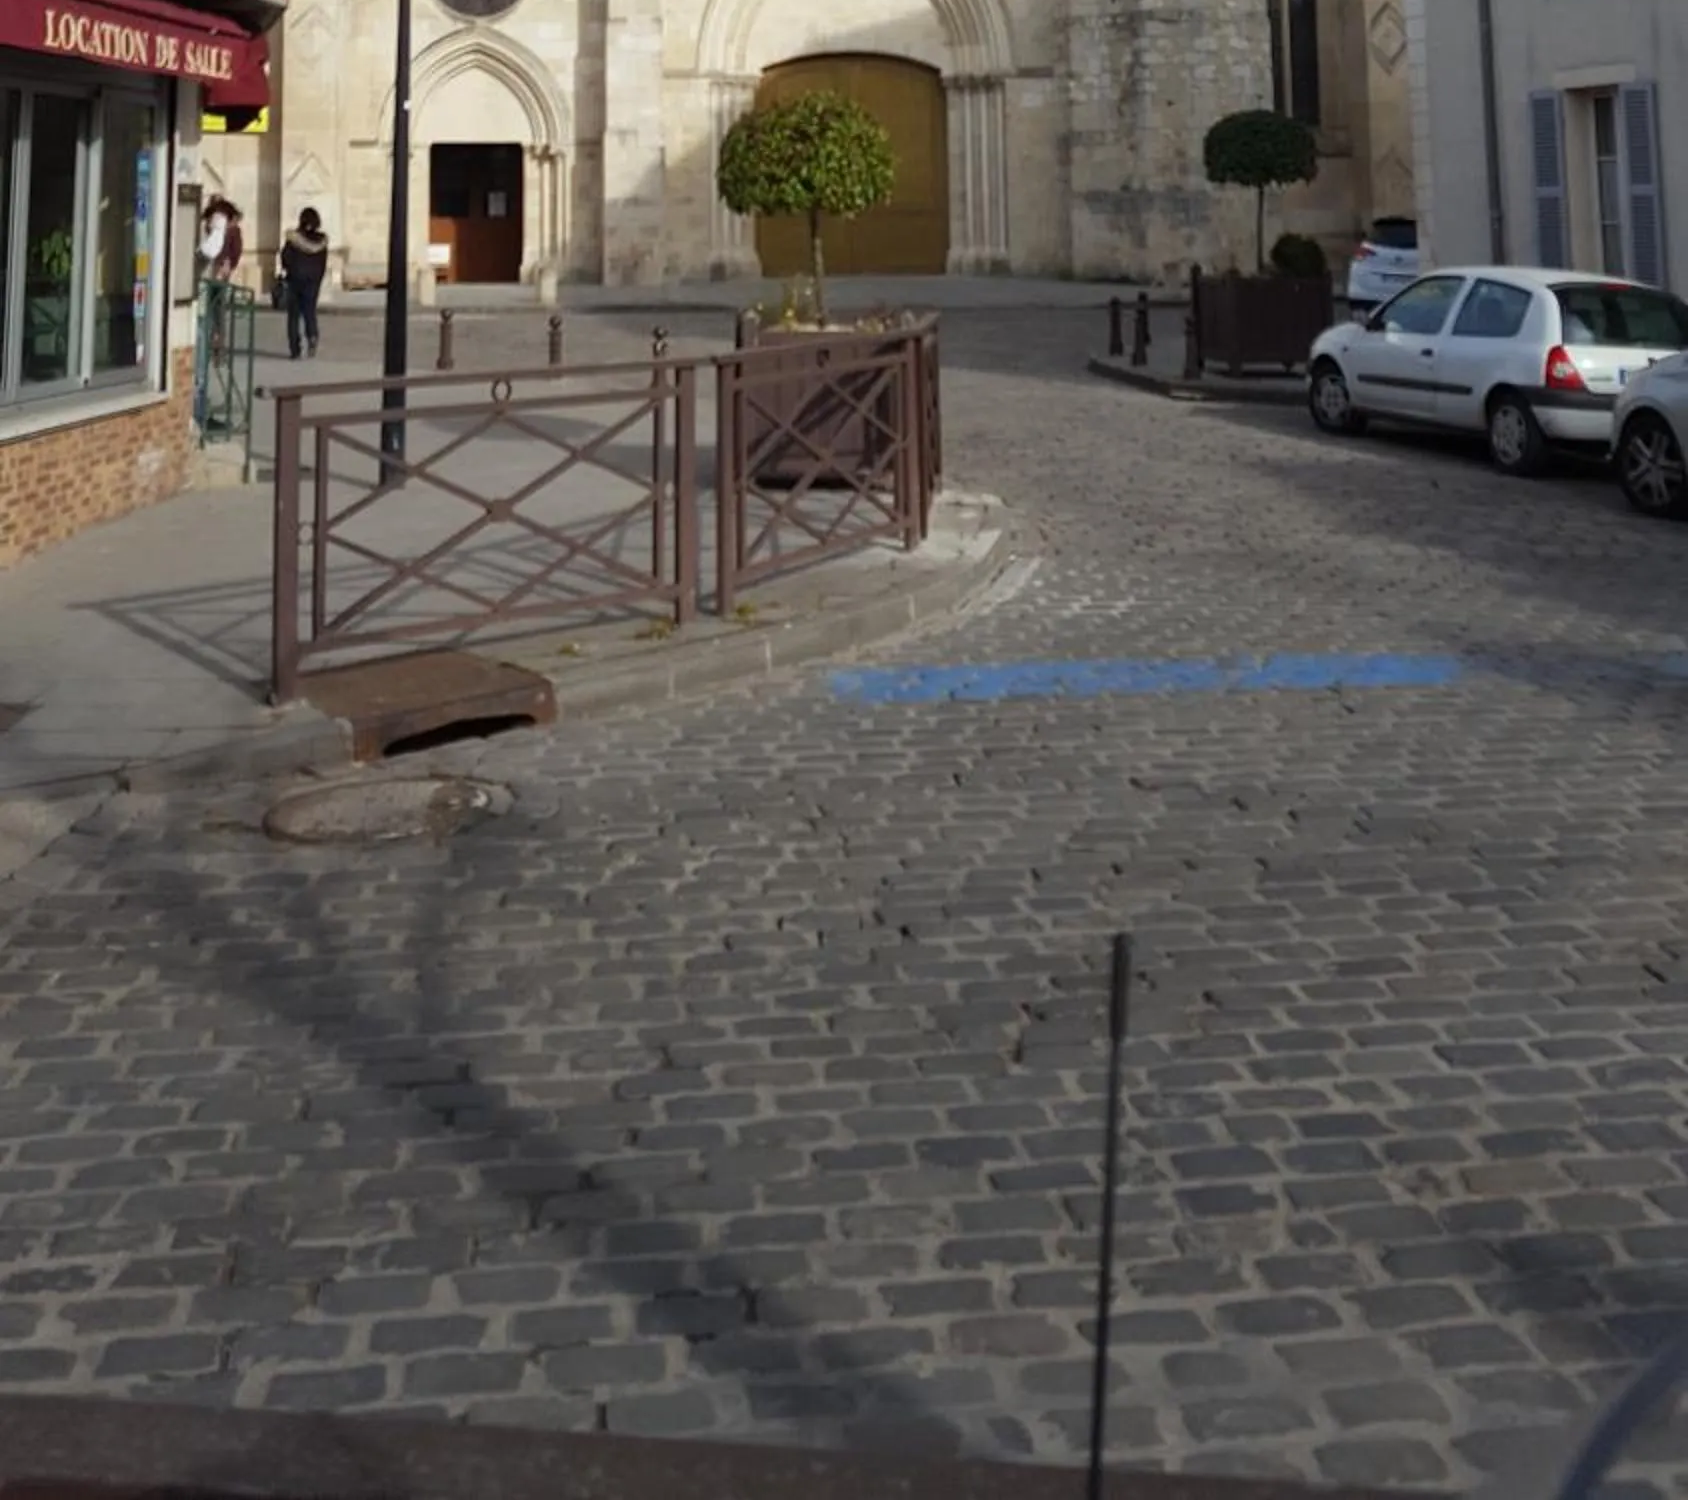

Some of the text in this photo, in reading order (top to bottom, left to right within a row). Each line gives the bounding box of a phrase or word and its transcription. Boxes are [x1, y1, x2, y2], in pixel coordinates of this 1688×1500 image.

[44, 9, 233, 80] LOCATION DE SALLE
